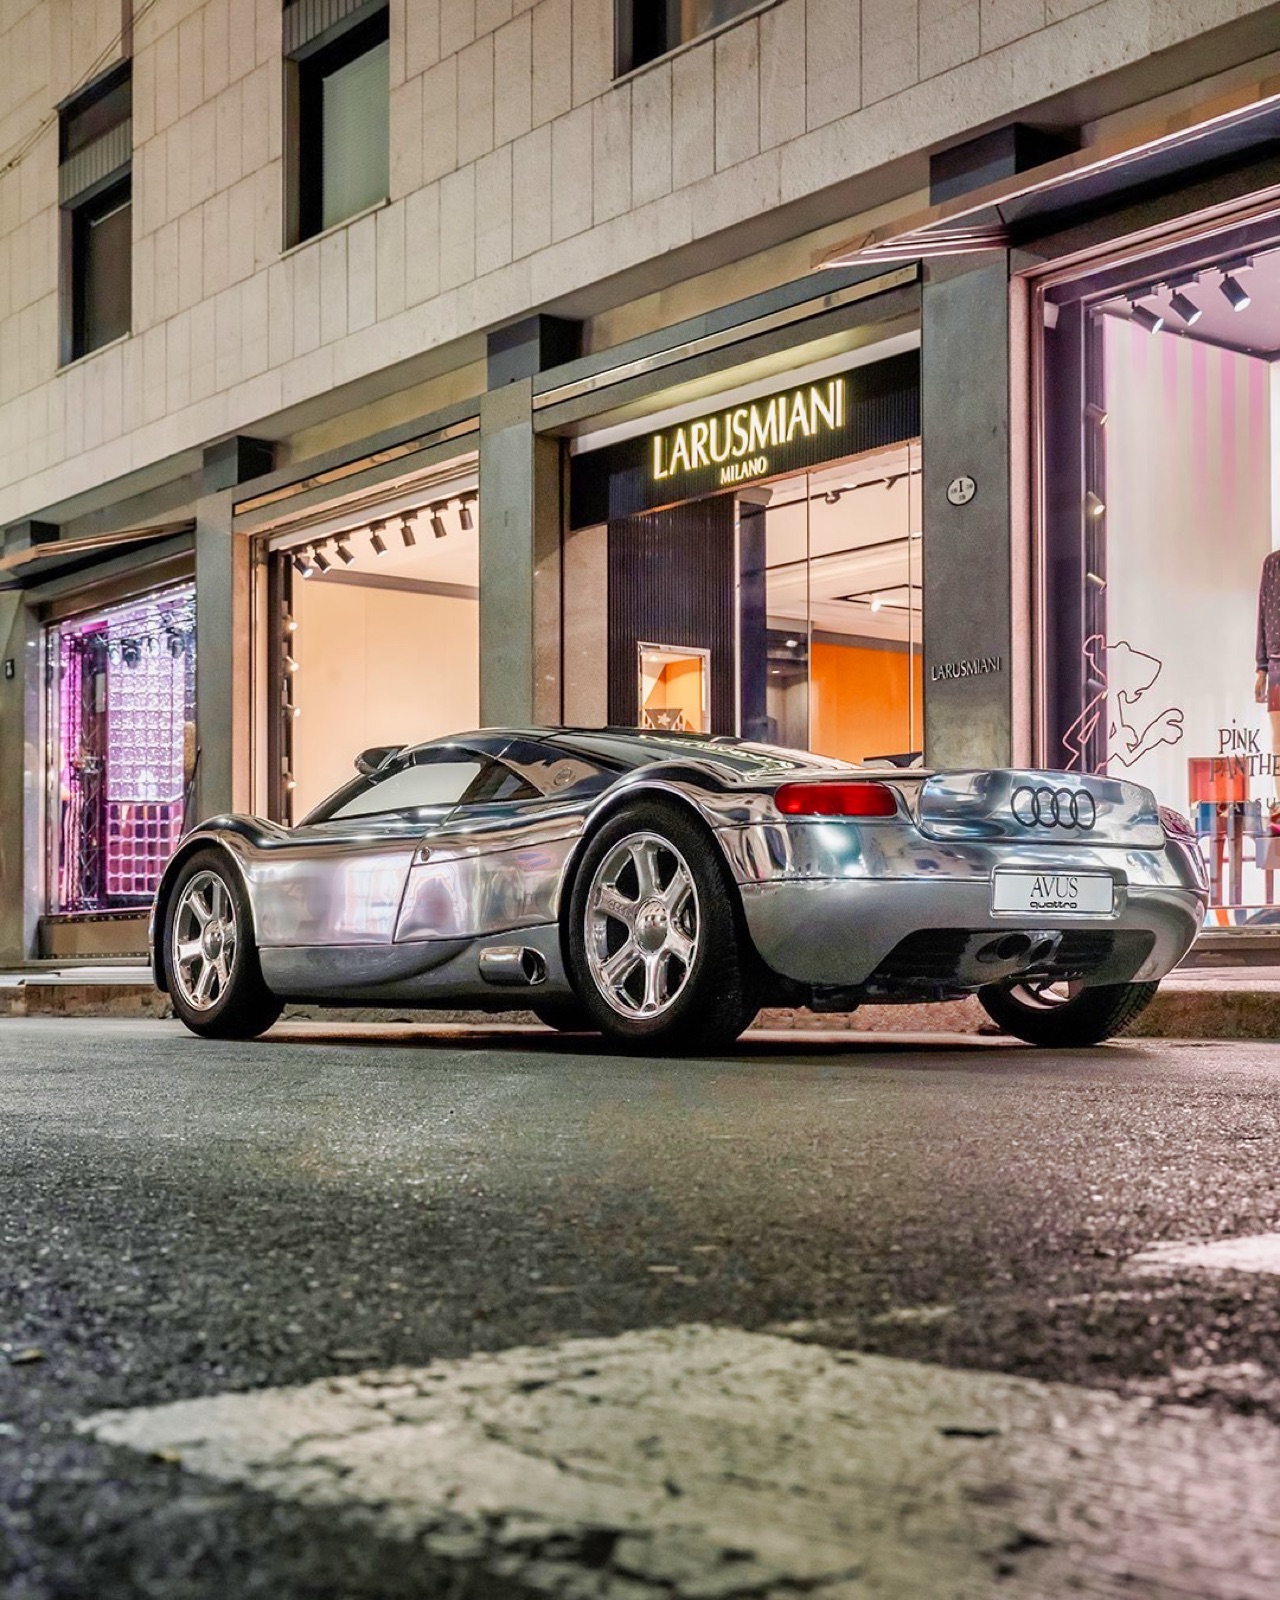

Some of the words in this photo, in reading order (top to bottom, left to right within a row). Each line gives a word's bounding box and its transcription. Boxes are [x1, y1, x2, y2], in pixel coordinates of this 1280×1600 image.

[653, 378, 845, 480] LARUSMIANI
[720, 455, 769, 485] MILANO
[931, 656, 1001, 681] LARUSMIANI
[1030, 876, 1078, 898] AVUS
[1029, 900, 1078, 909] quattro
